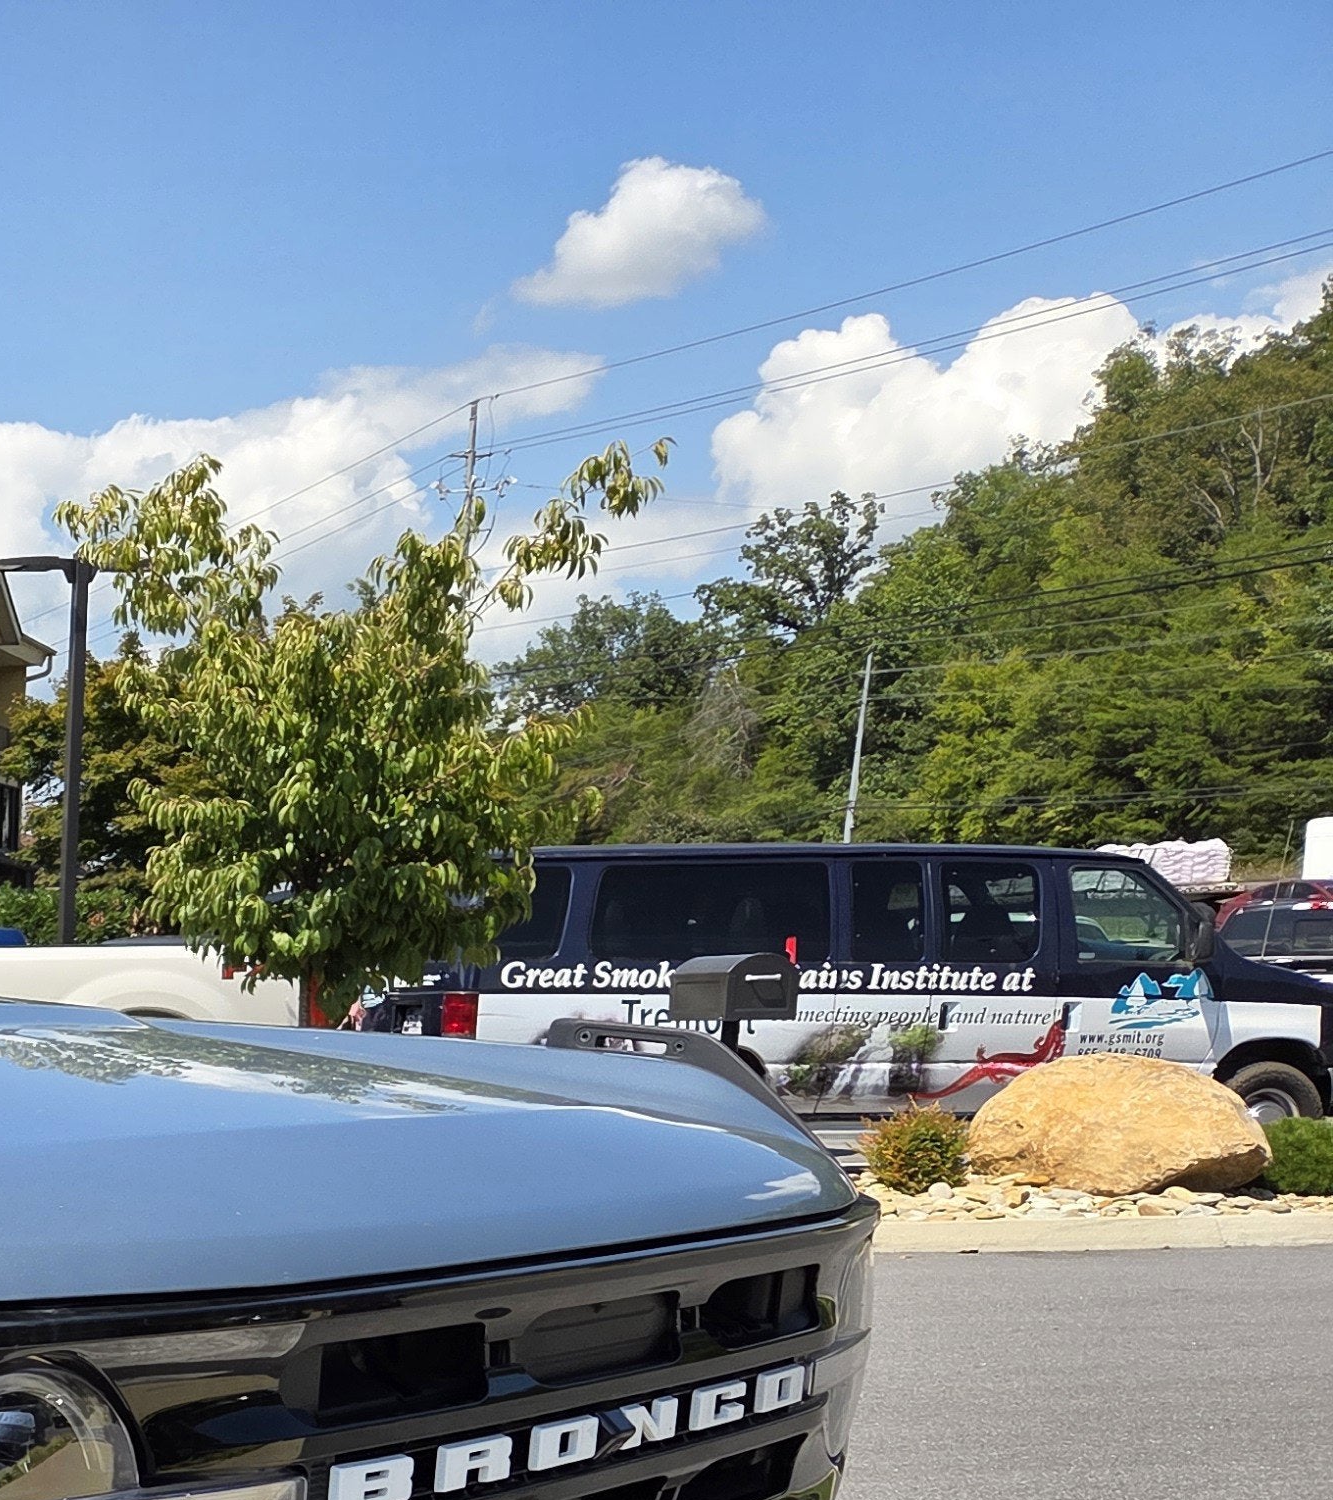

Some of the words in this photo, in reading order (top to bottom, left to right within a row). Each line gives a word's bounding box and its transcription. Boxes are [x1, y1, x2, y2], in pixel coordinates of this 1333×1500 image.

[500, 961, 587, 989] Great
[592, 961, 676, 989] Smok
[866, 963, 997, 991] Institute
[1001, 967, 1036, 991] at
[872, 1006, 938, 1029] people
[950, 1007, 988, 1025] and
[1079, 1031, 1165, 1047] www.gsmit.org
